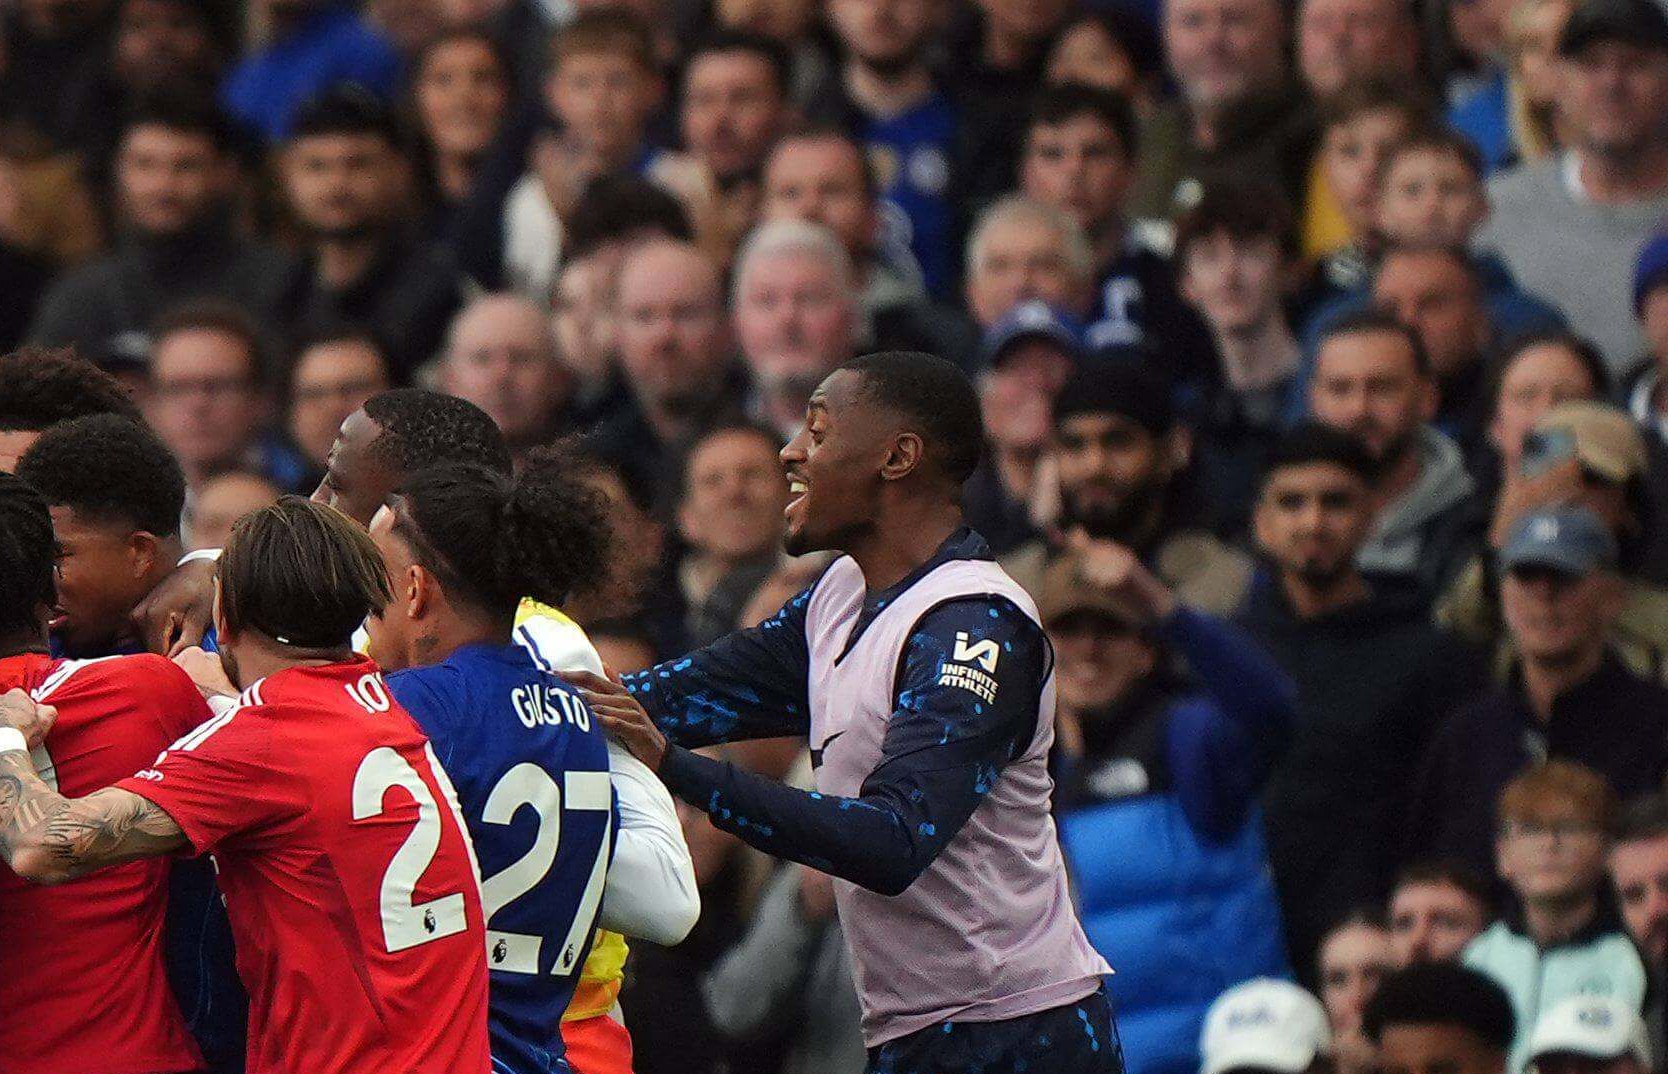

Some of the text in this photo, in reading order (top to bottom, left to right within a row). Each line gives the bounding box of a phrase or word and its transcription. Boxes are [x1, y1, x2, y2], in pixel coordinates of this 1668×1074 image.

[938, 675, 996, 704] ATHLETE
[941, 663, 999, 693] INFINITE
[511, 684, 590, 733] GUSTO
[352, 740, 487, 953] 2
[482, 762, 611, 976] 27
